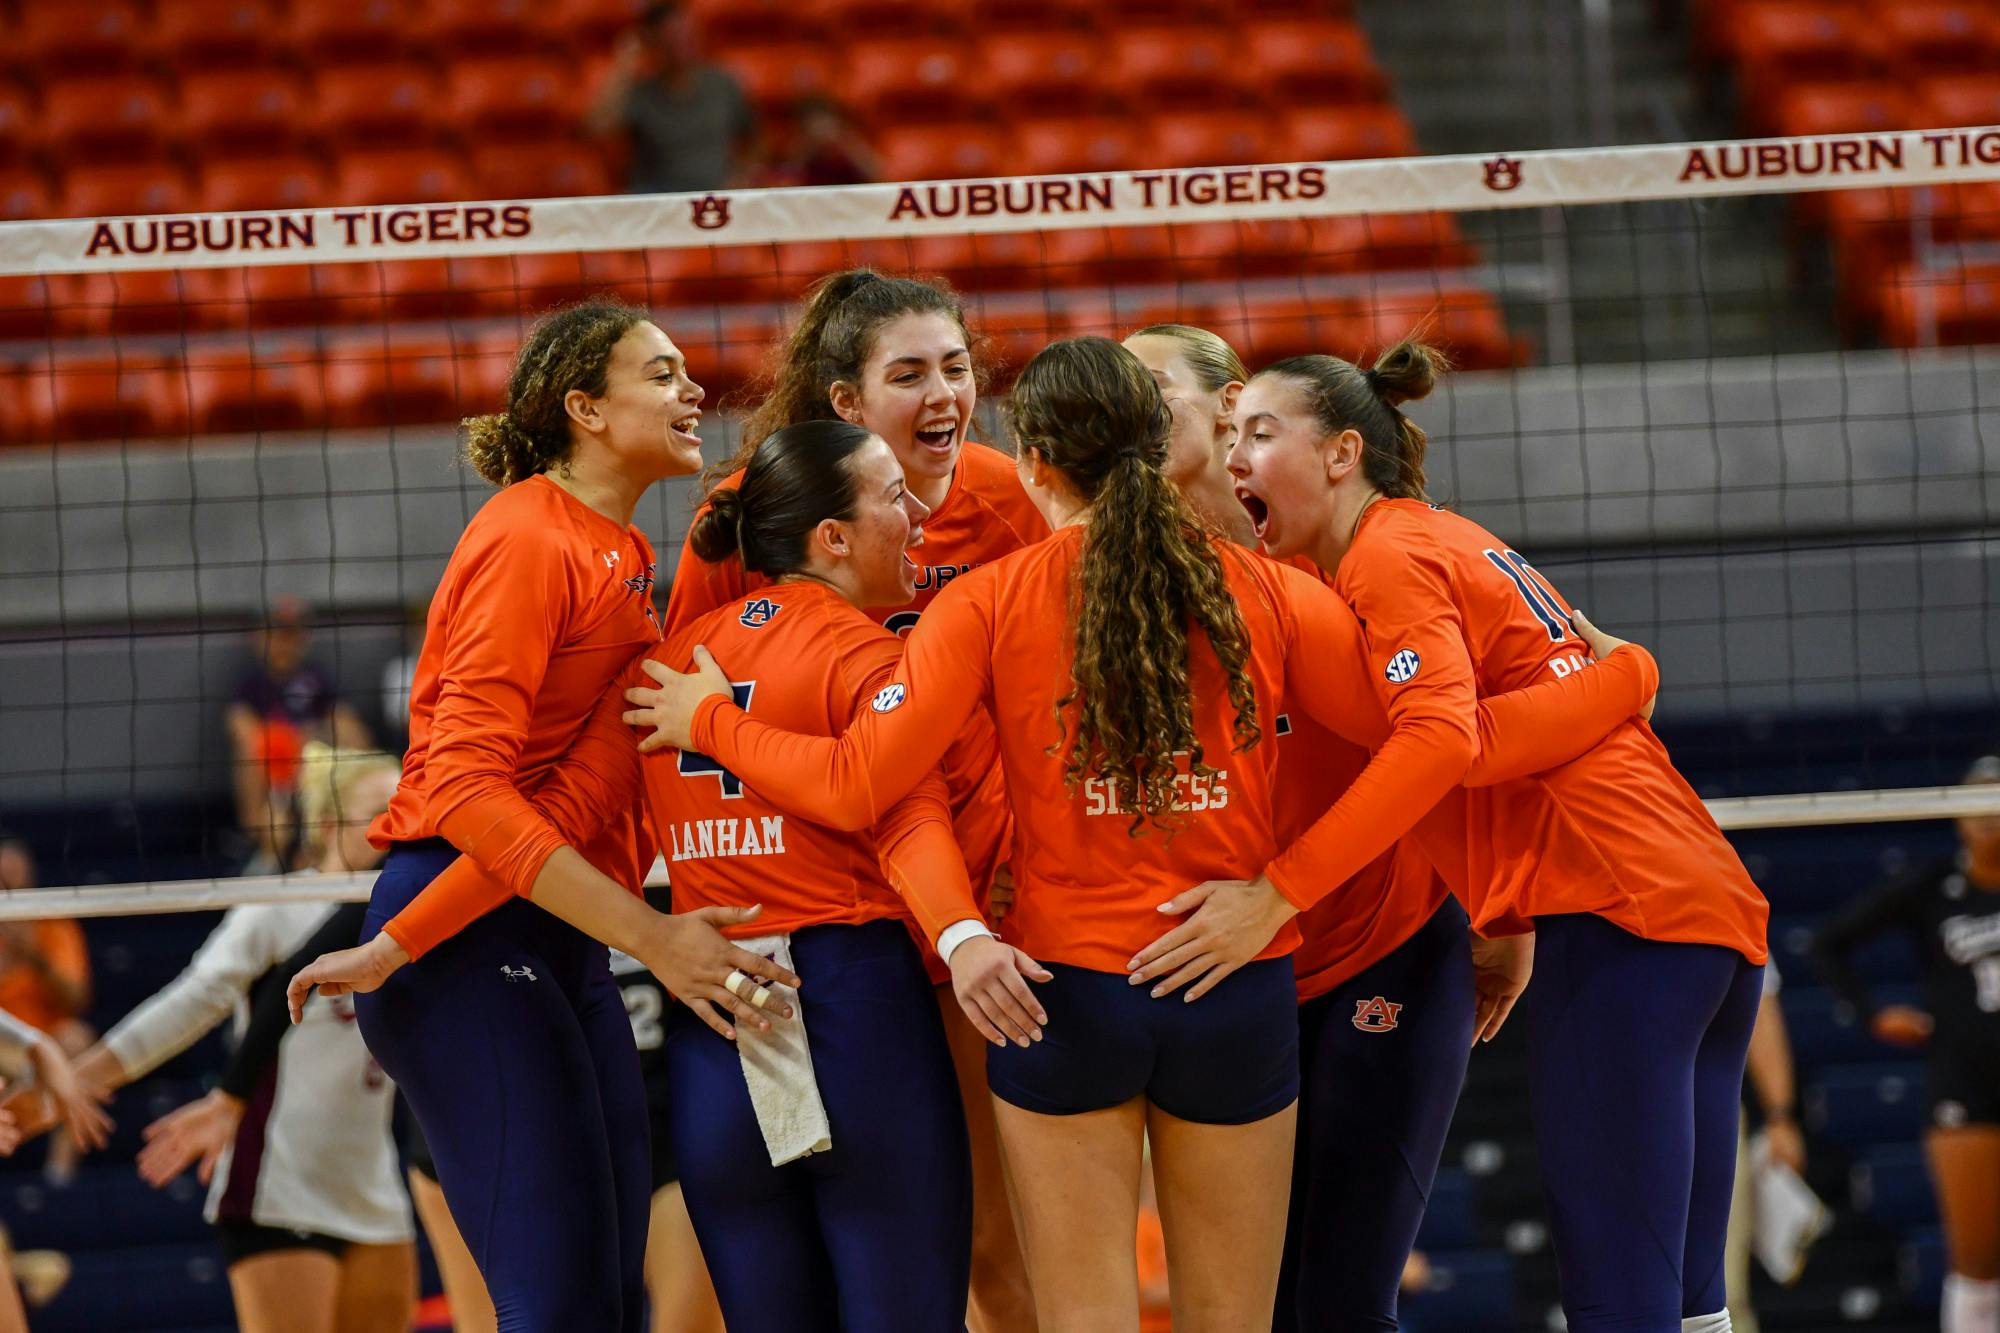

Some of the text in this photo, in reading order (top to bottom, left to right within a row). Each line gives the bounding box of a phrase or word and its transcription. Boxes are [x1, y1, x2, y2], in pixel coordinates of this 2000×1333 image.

[1680, 138, 1904, 180] AUBURN
[889, 167, 1327, 221] AUBURN TIGERS
[87, 205, 532, 256] AUBURN TIGERS
[1385, 648, 1420, 682] SEC
[872, 682, 906, 712] SEC
[670, 815, 786, 862] LANHAM
